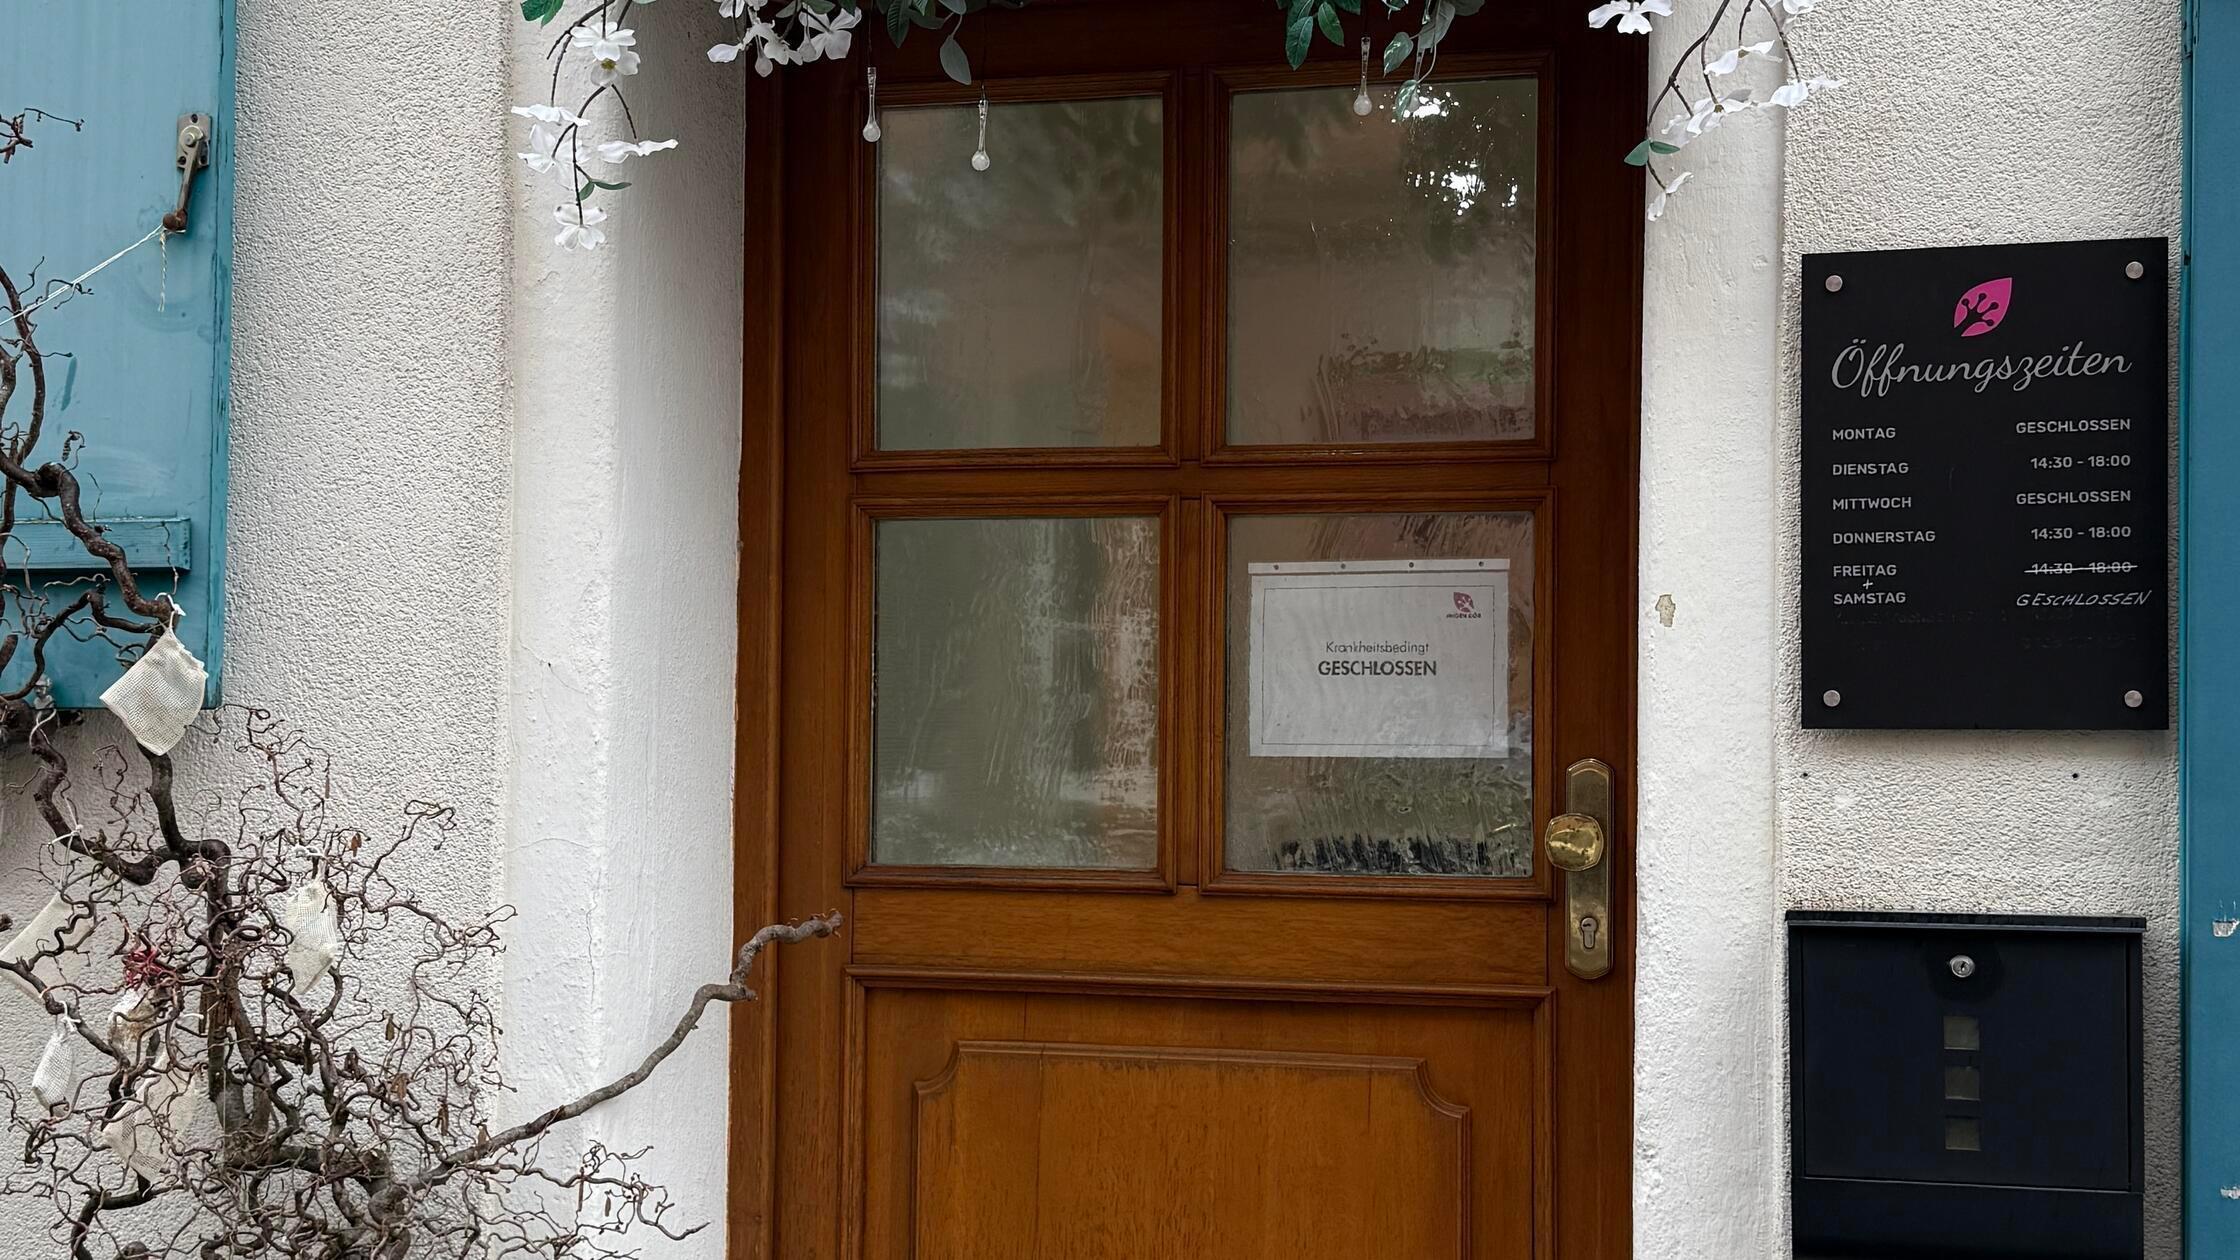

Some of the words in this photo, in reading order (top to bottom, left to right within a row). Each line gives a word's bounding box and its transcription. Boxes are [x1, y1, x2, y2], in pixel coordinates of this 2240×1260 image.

[1831, 339, 2132, 397] Öffnungszeiten
[1832, 427, 1897, 441] MONTAG
[2015, 418, 2131, 434] GESCHLOSSEN
[1832, 462, 1909, 476] DIENSTAG
[2030, 456, 2073, 469] 14:30
[2087, 454, 2131, 467] 18:00
[1832, 496, 1912, 510] MITTWOCH
[2016, 490, 2131, 505] GESCHLOSSEN
[1833, 530, 1936, 544] DONNERSTAG
[2031, 527, 2073, 540] 14:30
[2088, 526, 2131, 538] 18:00
[1833, 564, 1897, 577] FREITAG
[1833, 592, 1906, 605] SAMSTAG
[2016, 589, 2152, 606] GESCHLOSSEN
[1325, 640, 1429, 656] Krankheitsbedingt
[1318, 660, 1437, 676] GESCHLOSSEN
